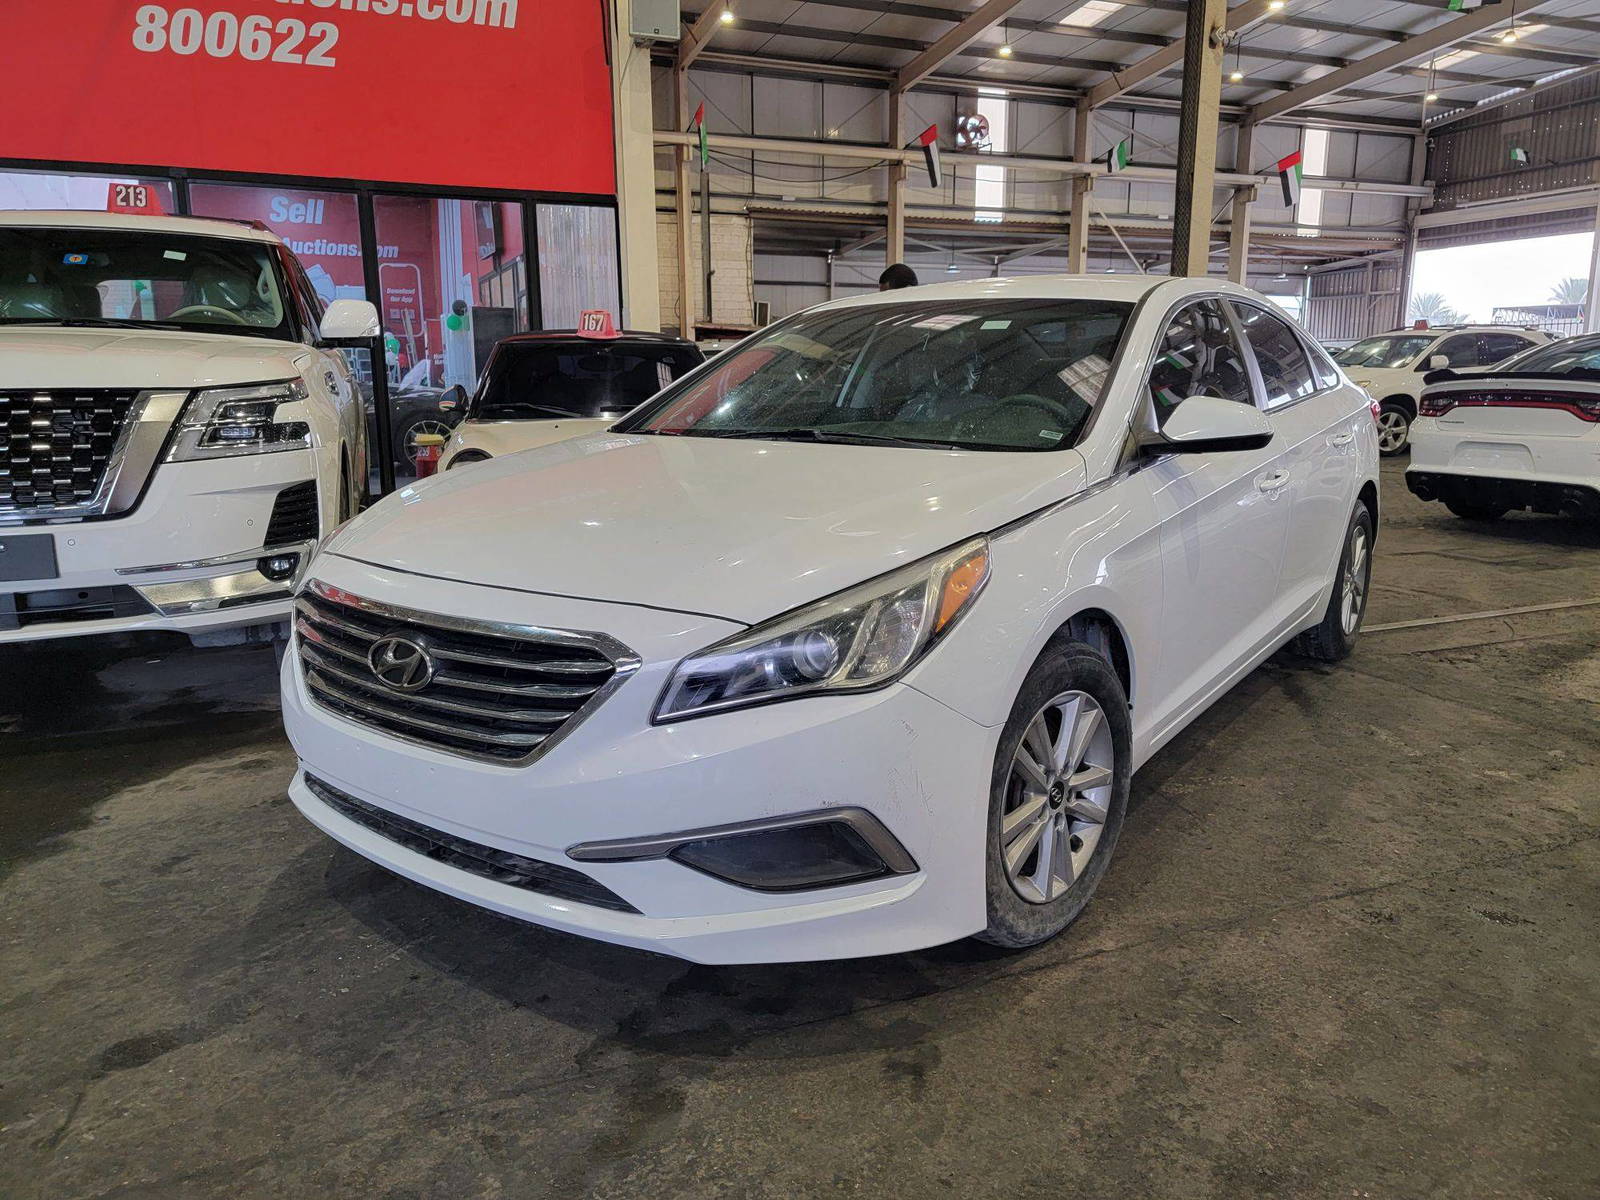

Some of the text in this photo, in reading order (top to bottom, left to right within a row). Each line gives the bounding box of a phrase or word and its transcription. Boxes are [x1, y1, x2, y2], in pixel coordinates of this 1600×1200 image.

[132, 4, 340, 67] 800622
[116, 185, 146, 207] 213
[269, 196, 325, 225] Sell
[584, 314, 603, 331] 167
